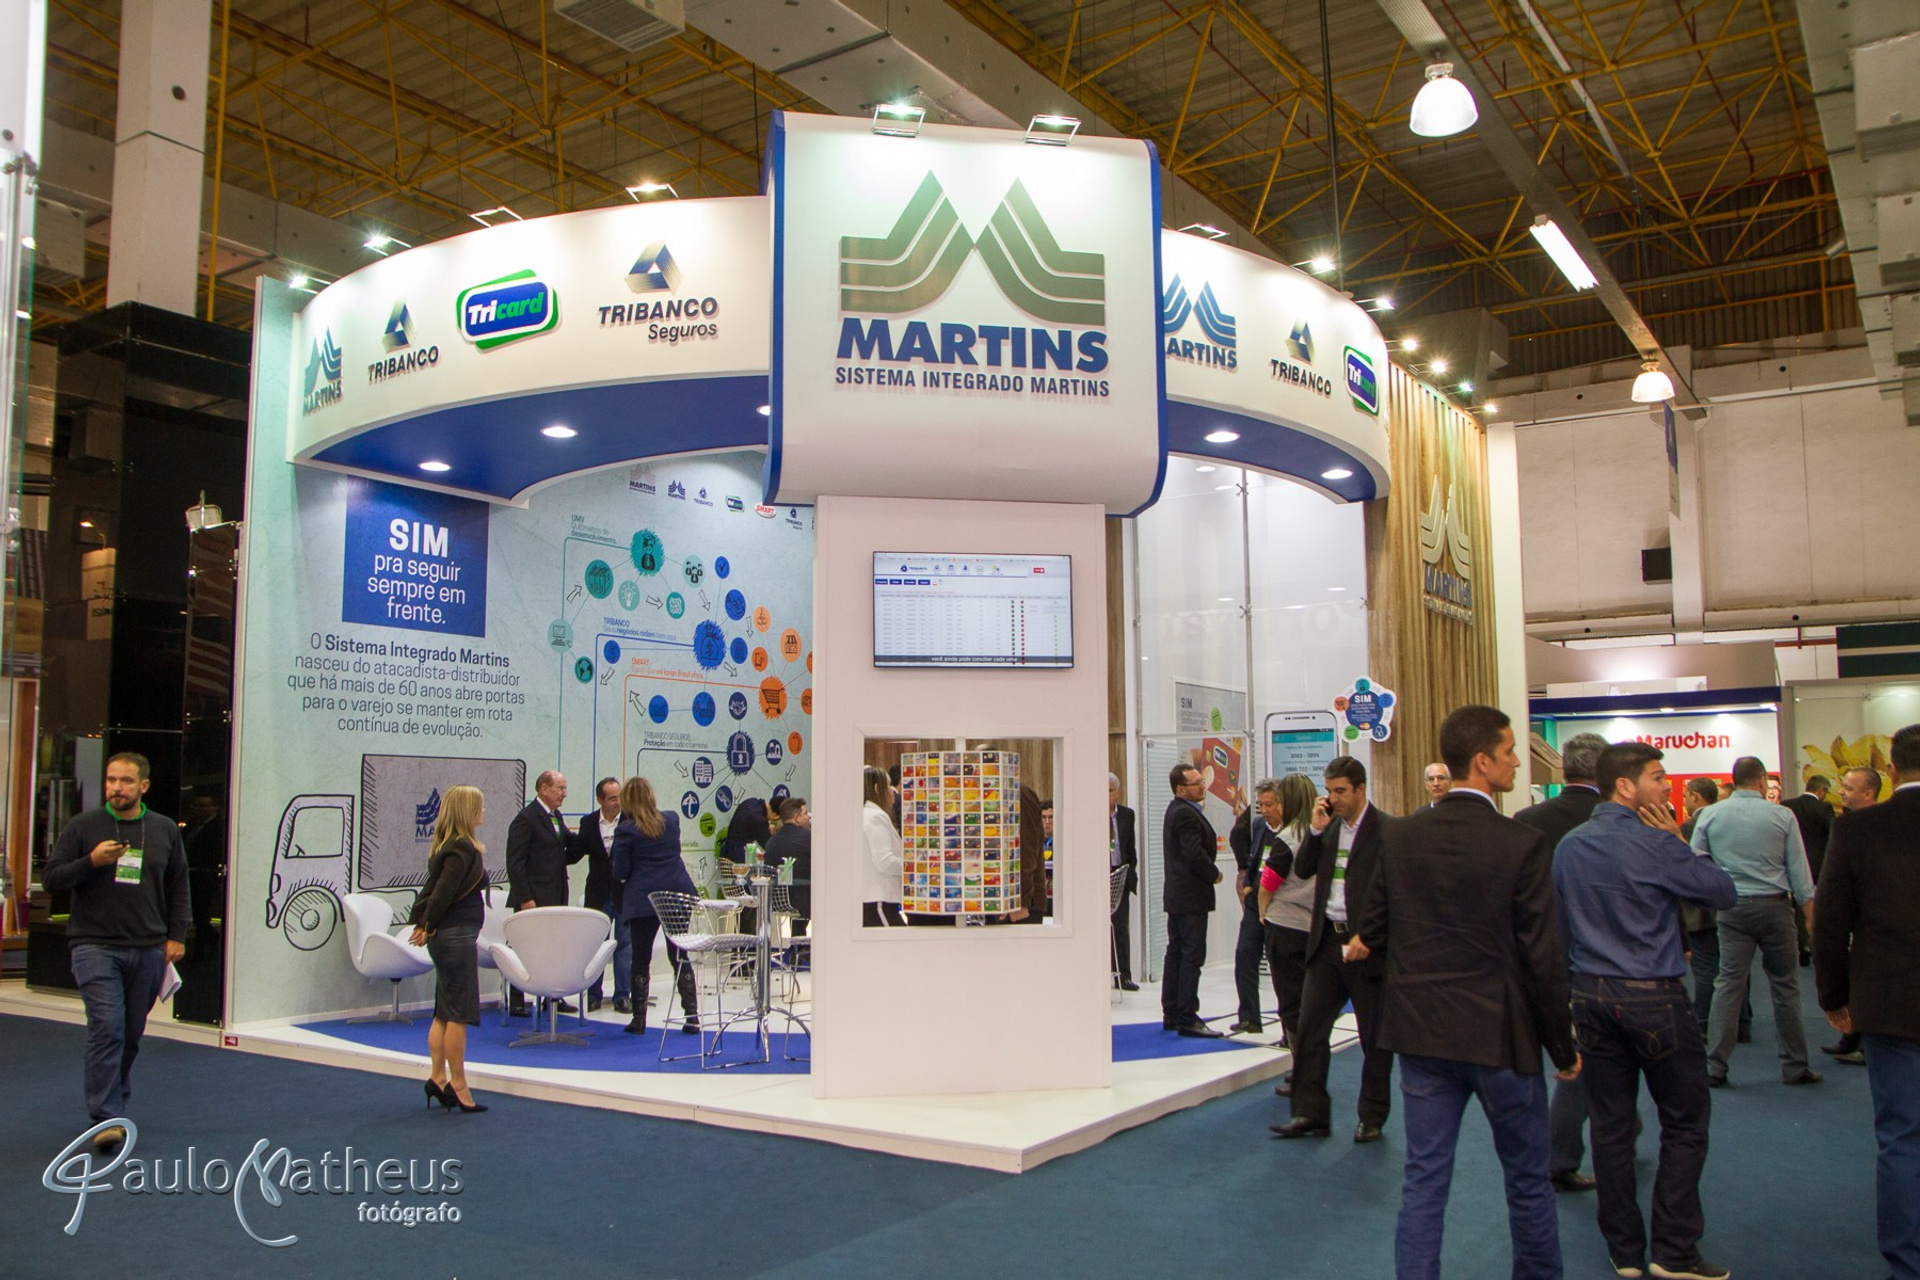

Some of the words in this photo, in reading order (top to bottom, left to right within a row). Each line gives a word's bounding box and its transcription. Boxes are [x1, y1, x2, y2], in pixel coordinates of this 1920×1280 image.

[467, 292, 544, 326] Tricard
[599, 297, 718, 325] TRIBANCO
[648, 323, 718, 342] Seguros
[836, 317, 1109, 373] MARTINS
[368, 345, 439, 380] TRIBANCO
[1167, 337, 1237, 369] ARTINS
[835, 367, 916, 387] SISTEMA
[923, 371, 1024, 392] INTEGRADO
[1030, 376, 1109, 397] MARTINS
[1271, 358, 1332, 396] TRIBANCO
[303, 379, 342, 414] MARTINS
[388, 518, 449, 558] SIM
[374, 554, 403, 575] pra
[407, 559, 461, 584] seguir
[367, 576, 435, 602] sempre
[439, 586, 466, 605] em
[386, 596, 447, 625] frente.
[310, 632, 322, 650] O
[325, 634, 387, 656] Sistema
[391, 641, 457, 664] Integrado
[460, 648, 510, 667] Martins
[295, 655, 350, 672] nasceu
[352, 657, 371, 674] do
[374, 662, 520, 687] atacadista-distribuidor
[287, 673, 316, 691] que
[319, 673, 337, 691] há
[341, 677, 375, 694] mais
[378, 678, 395, 696] de
[398, 680, 417, 697] 60
[420, 683, 452, 699] anos
[455, 685, 483, 702] abre
[485, 689, 525, 706] portas
[1180, 697, 1193, 709] SIM
[1354, 694, 1372, 703] SIM
[302, 695, 335, 712] para
[338, 698, 348, 711] o
[351, 697, 393, 717] varejo
[396, 701, 413, 715] se
[416, 701, 463, 718] manter
[466, 706, 486, 720] em
[488, 707, 513, 721] rota
[337, 715, 399, 734] contínua
[402, 718, 420, 735] de
[422, 720, 484, 741] evolução.
